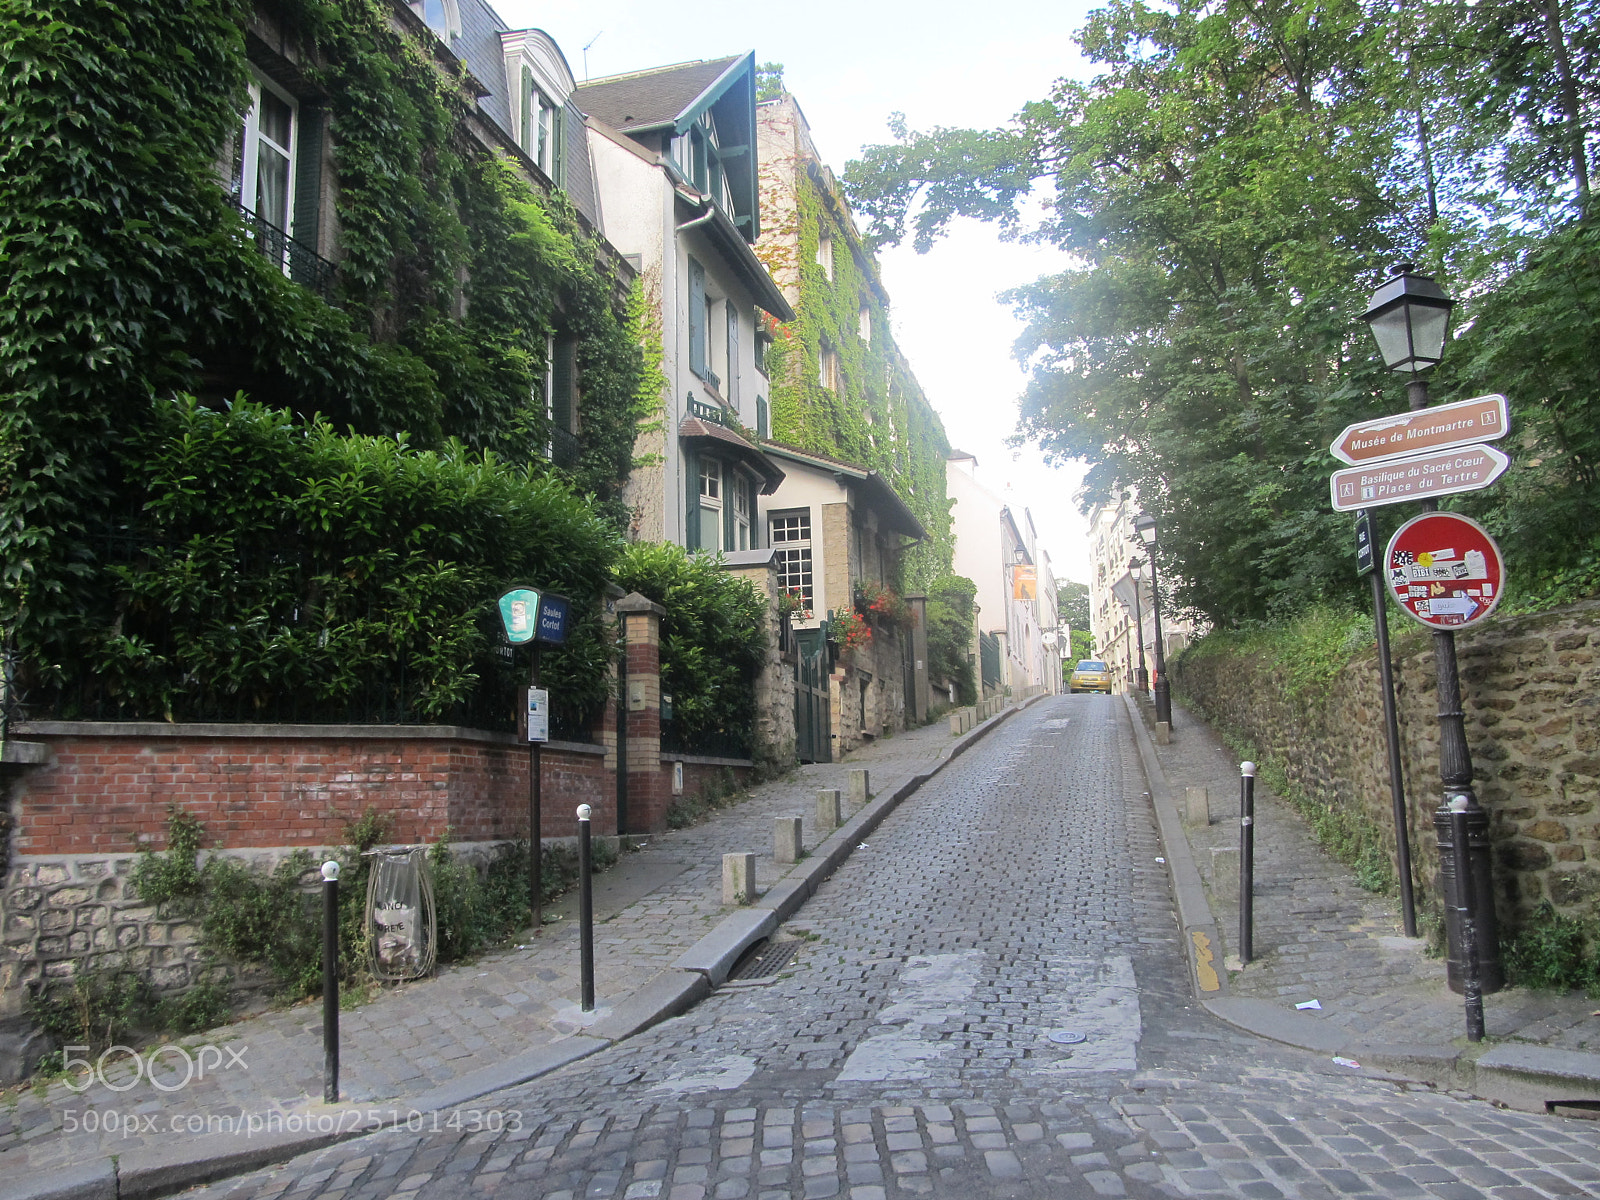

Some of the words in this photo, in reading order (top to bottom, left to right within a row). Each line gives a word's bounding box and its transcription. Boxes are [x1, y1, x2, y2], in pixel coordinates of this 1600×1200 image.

[1351, 436, 1386, 451] Musée
[1390, 431, 1403, 443] de
[1406, 418, 1474, 440] Montmartre
[1360, 470, 1405, 486] Basilique
[1407, 465, 1420, 477] du
[1422, 459, 1452, 475] Sacré
[1378, 481, 1411, 496] Place
[1418, 477, 1433, 489] du
[1441, 471, 1479, 485] Tertre
[1394, 556, 1413, 566] 246
[543, 606, 562, 619] Saules
[542, 618, 560, 631] Cortot
